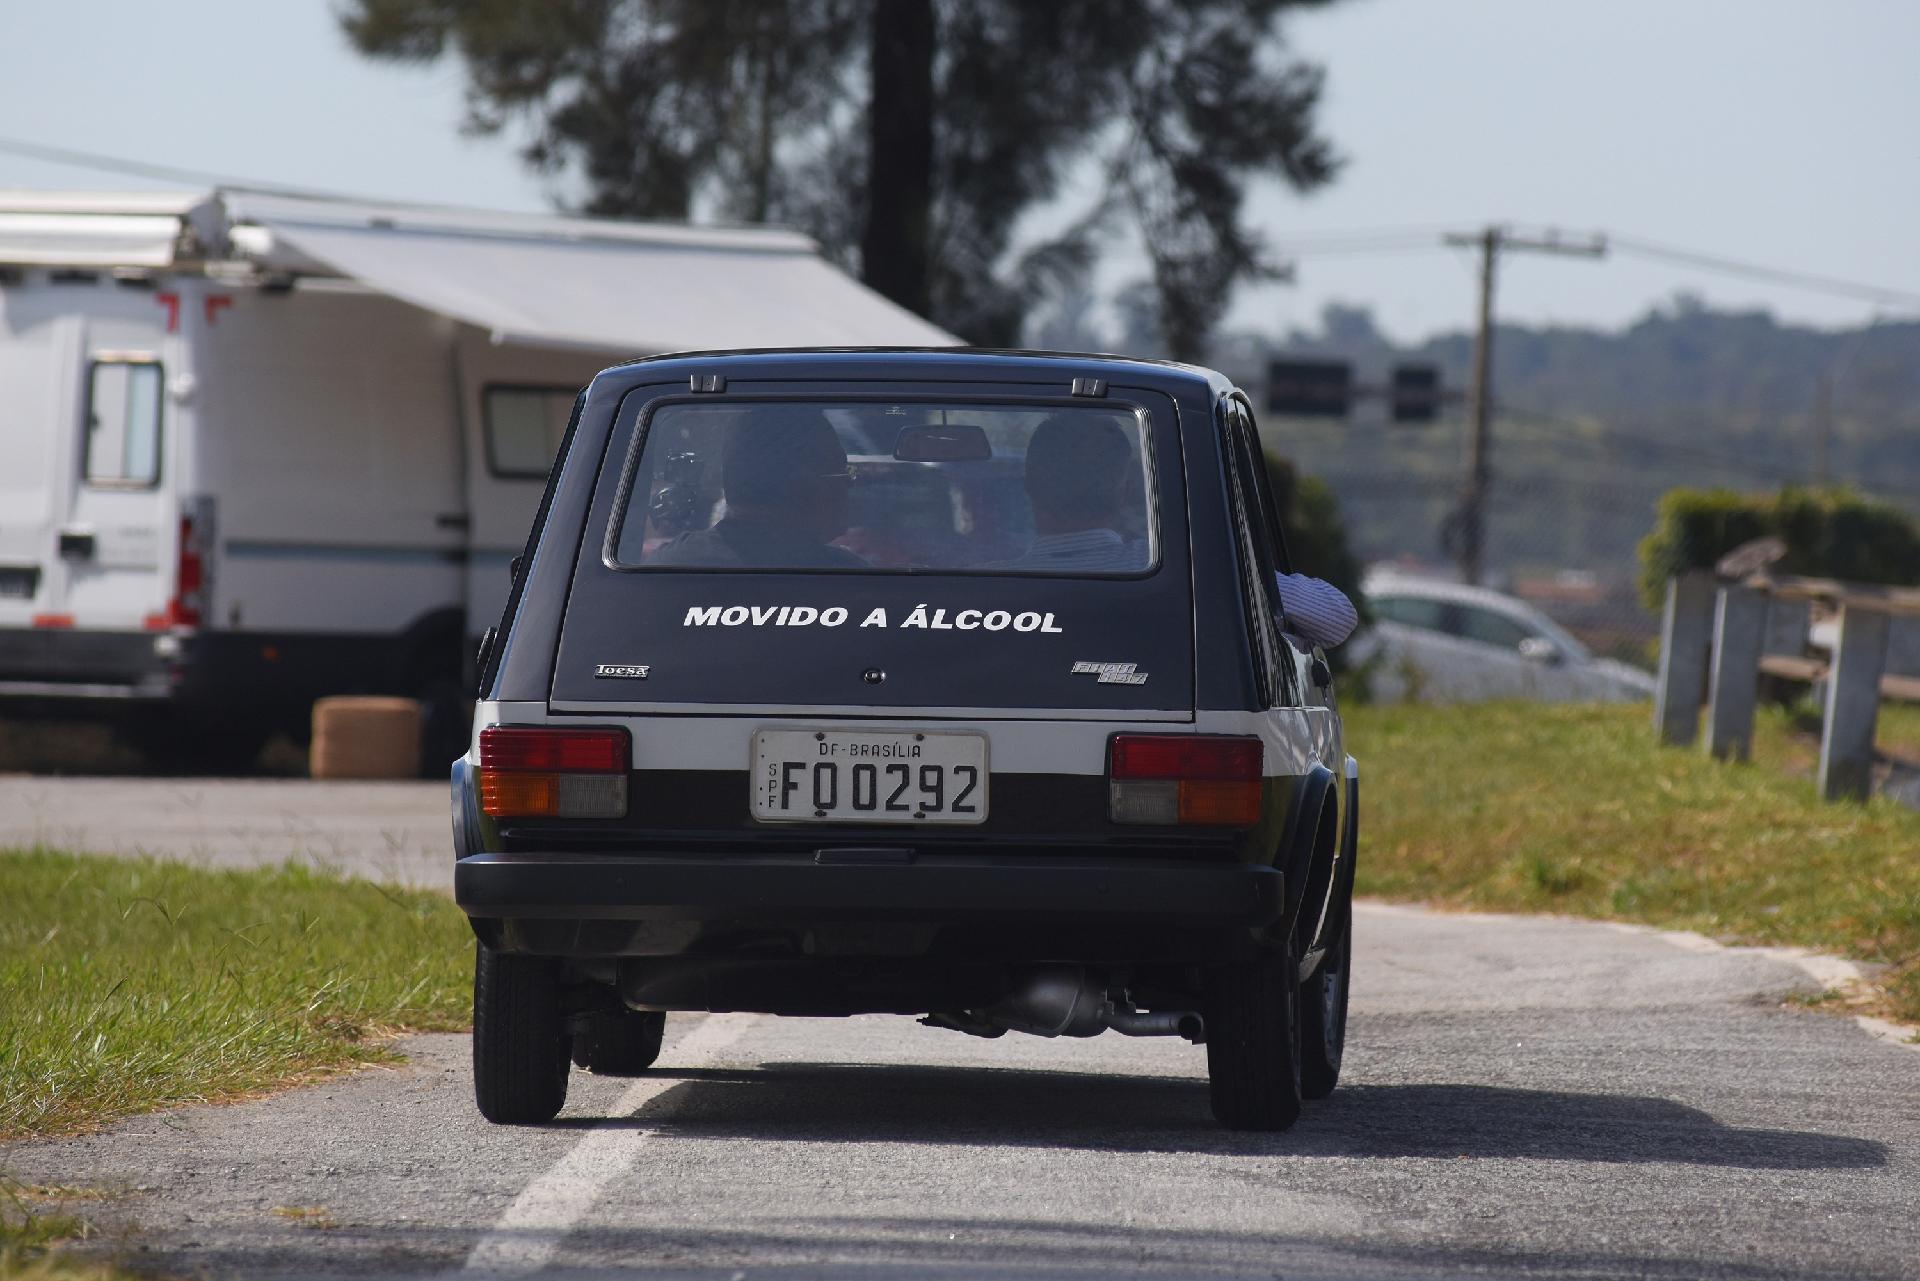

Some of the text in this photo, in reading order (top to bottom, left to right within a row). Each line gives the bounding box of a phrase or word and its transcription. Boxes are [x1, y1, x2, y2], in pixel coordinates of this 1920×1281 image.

[684, 603, 1063, 633] MOVIDO A ÁLCOOL
[597, 664, 646, 676] Toesa
